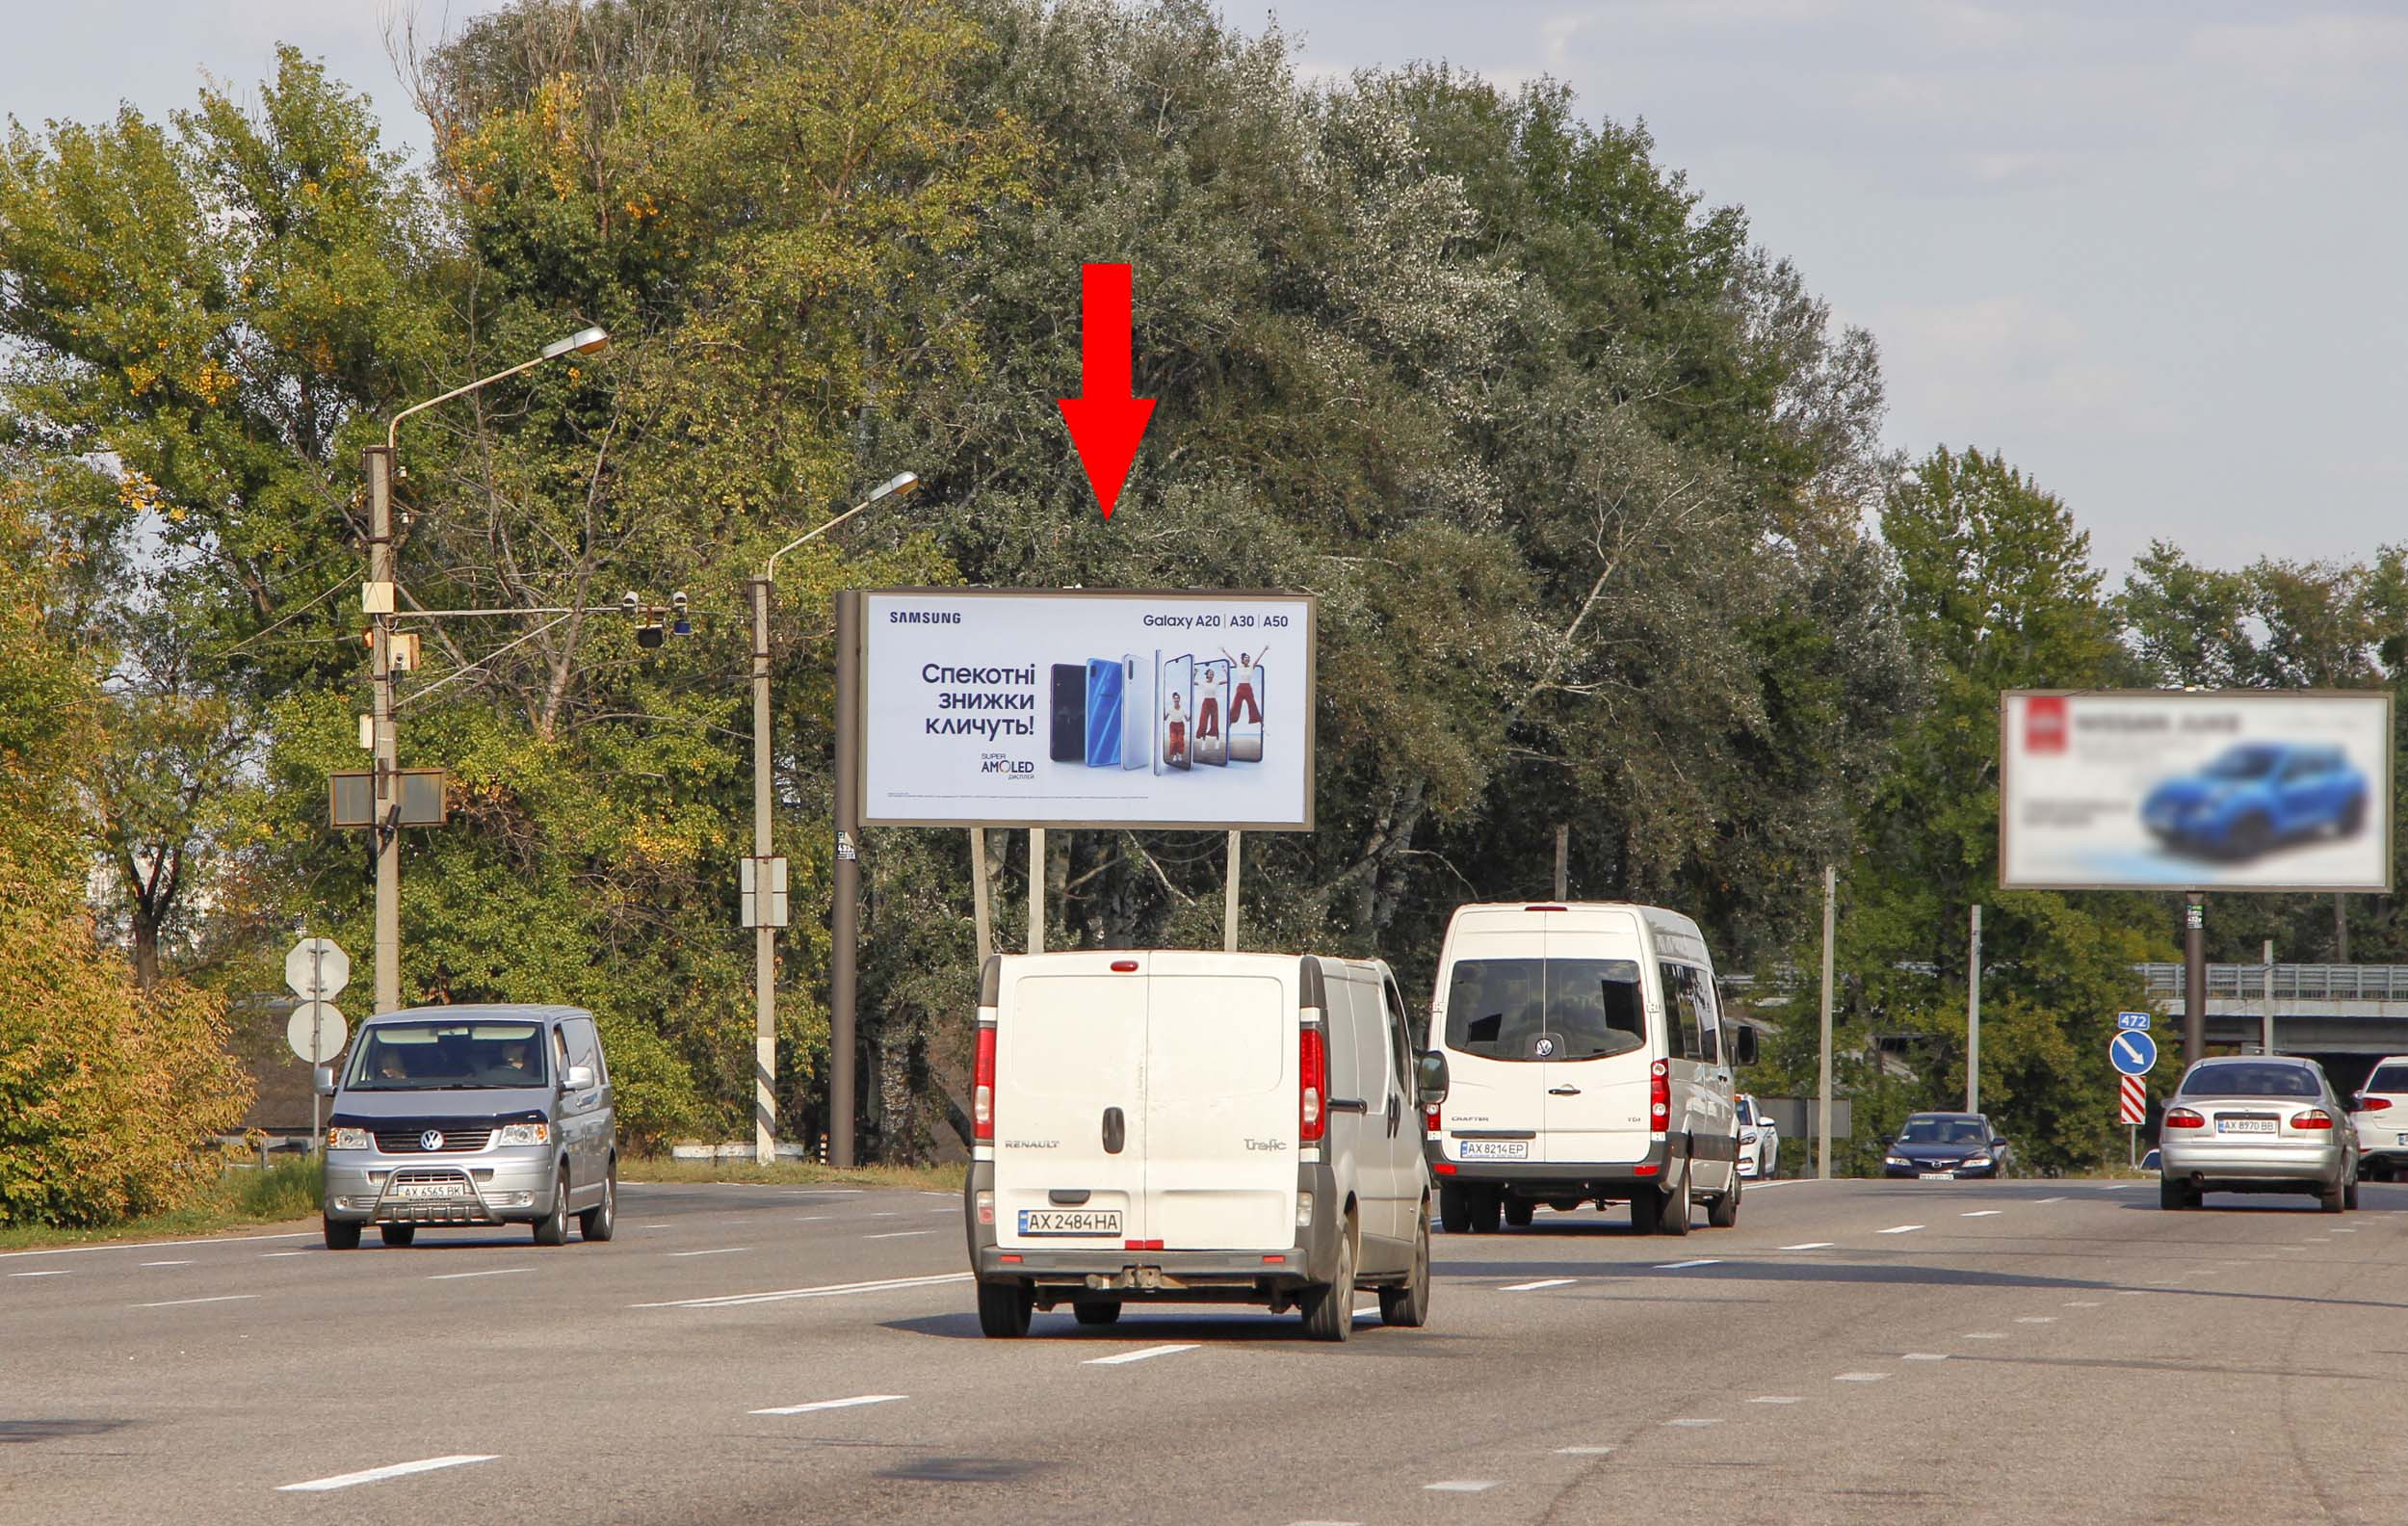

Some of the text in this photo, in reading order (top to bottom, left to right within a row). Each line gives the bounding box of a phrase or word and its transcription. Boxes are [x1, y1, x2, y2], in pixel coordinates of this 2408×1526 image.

[890, 611, 961, 624] SAMSUNG
[1143, 614, 1289, 629] Galaxy A20 A30 A50
[922, 662, 1035, 686] Спекотні
[938, 693, 1034, 710] знижки
[926, 716, 1034, 741] кличуть!
[982, 760, 1034, 774] AMOLED
[2121, 1014, 2147, 1028] 472
[2225, 1120, 2274, 1131] AX 8970 BB
[1005, 1140, 1060, 1148] RENAULT
[1243, 1138, 1287, 1152] Trafic
[1468, 1144, 1525, 1154] AX 8214 EP
[406, 1186, 461, 1197] AX 6565 BK
[1030, 1214, 1118, 1230] AX 2484 HA
